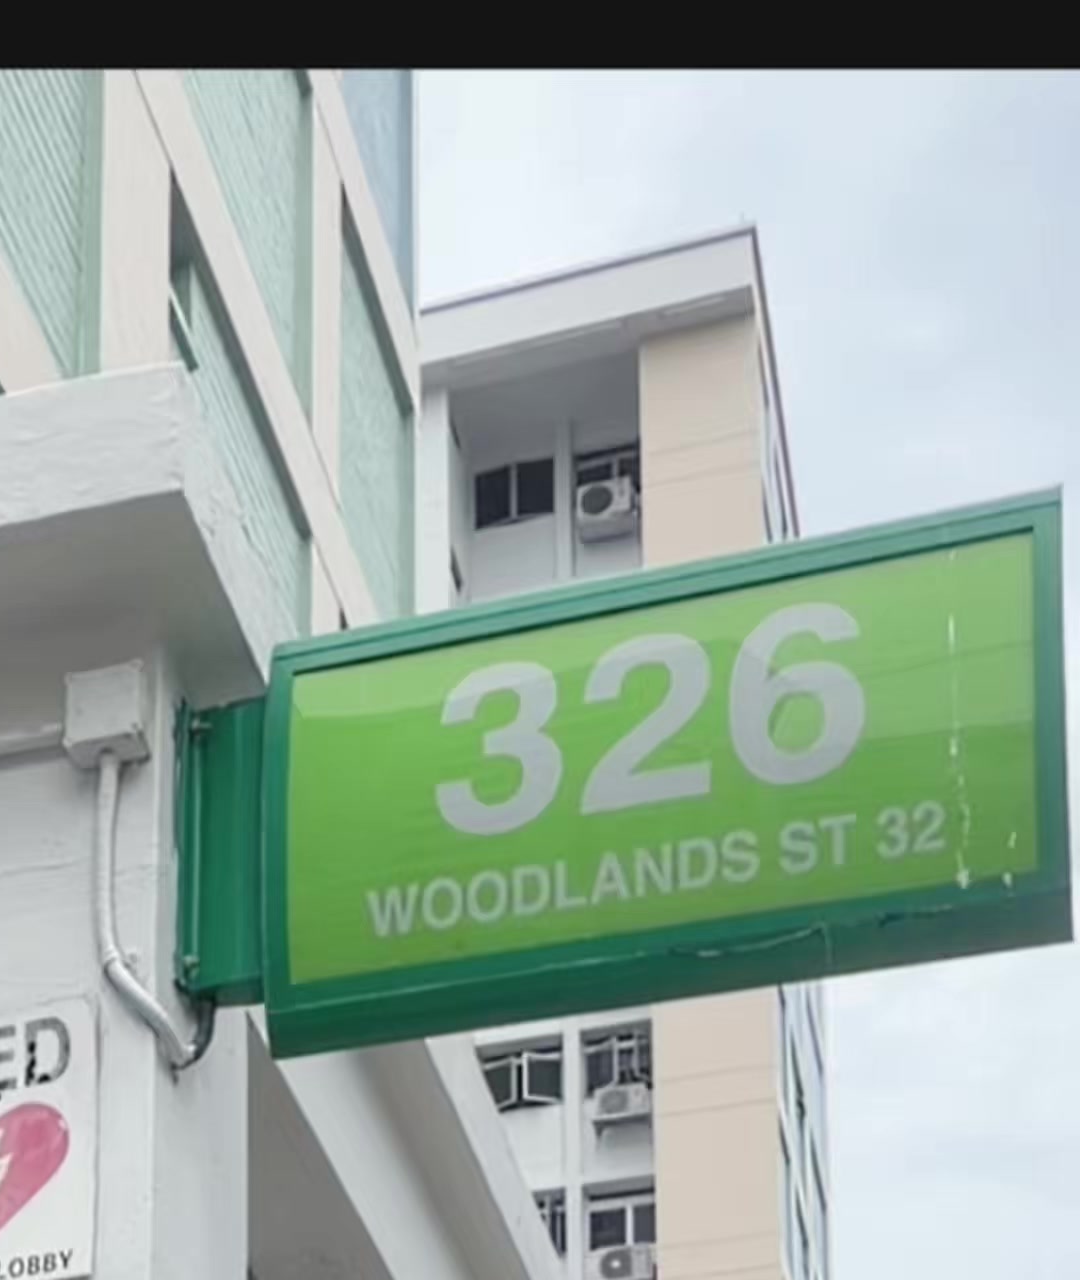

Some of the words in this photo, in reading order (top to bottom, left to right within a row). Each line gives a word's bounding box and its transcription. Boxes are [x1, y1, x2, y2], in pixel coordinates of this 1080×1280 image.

[435, 602, 866, 836] 326
[367, 829, 760, 939] WOODLANDS
[778, 814, 858, 875] ST
[877, 802, 948, 860] 32
